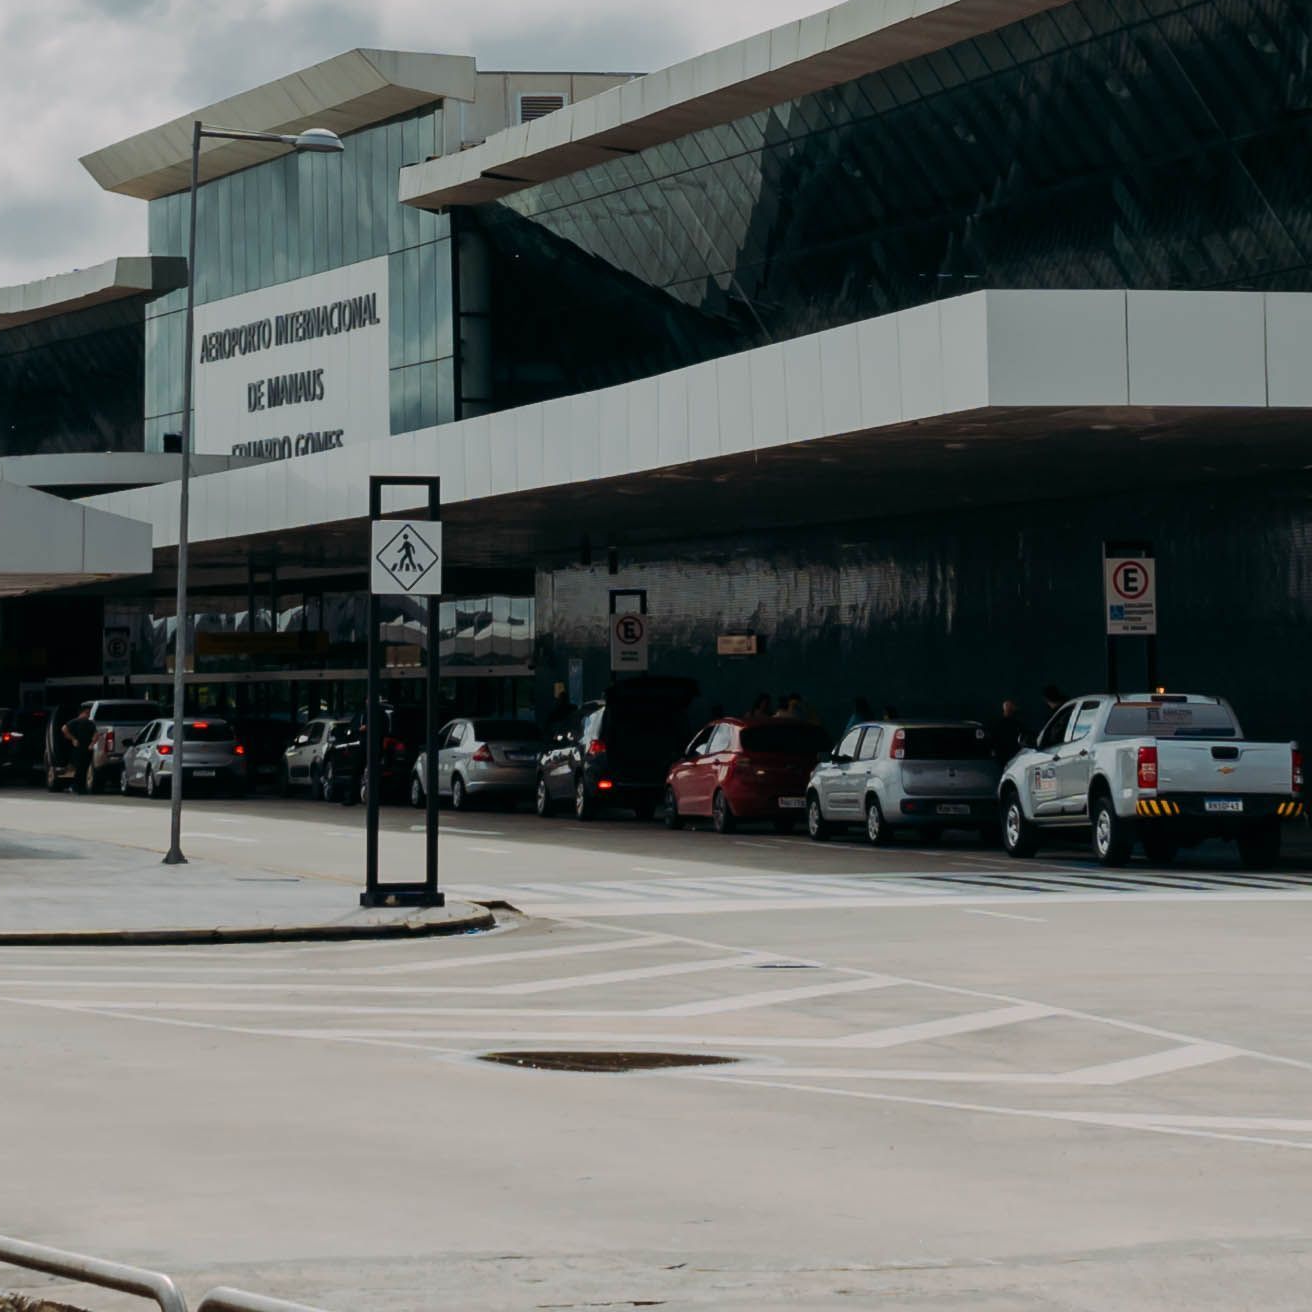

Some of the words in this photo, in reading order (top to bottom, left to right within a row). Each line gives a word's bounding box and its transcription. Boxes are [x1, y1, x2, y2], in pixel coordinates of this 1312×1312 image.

[200, 318, 272, 364] AEROPORTO
[275, 293, 380, 346] INTERNACIONAL
[247, 380, 265, 413] DE
[267, 368, 324, 408] MANAUS
[1123, 568, 1139, 592] E
[624, 621, 636, 639] E
